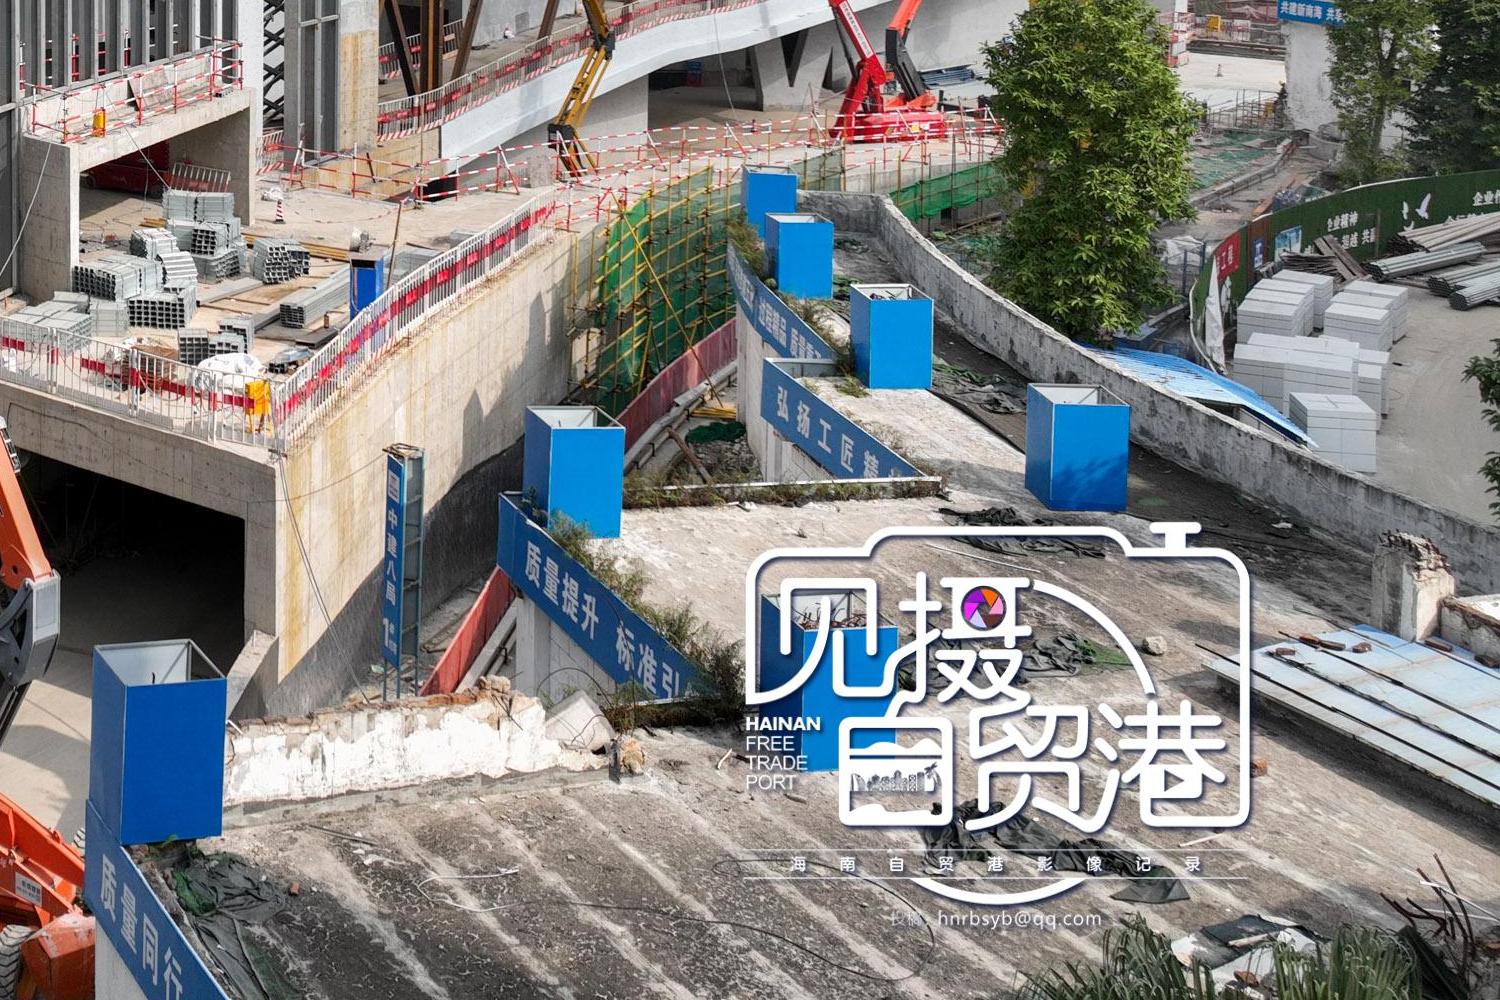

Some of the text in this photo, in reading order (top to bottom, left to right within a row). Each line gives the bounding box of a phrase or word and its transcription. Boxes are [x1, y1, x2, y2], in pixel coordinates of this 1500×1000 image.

[777, 385, 900, 478] 弘扬工匠精
[385, 508, 398, 607] 中建八局
[525, 541, 700, 698] 质量提升 标准引
